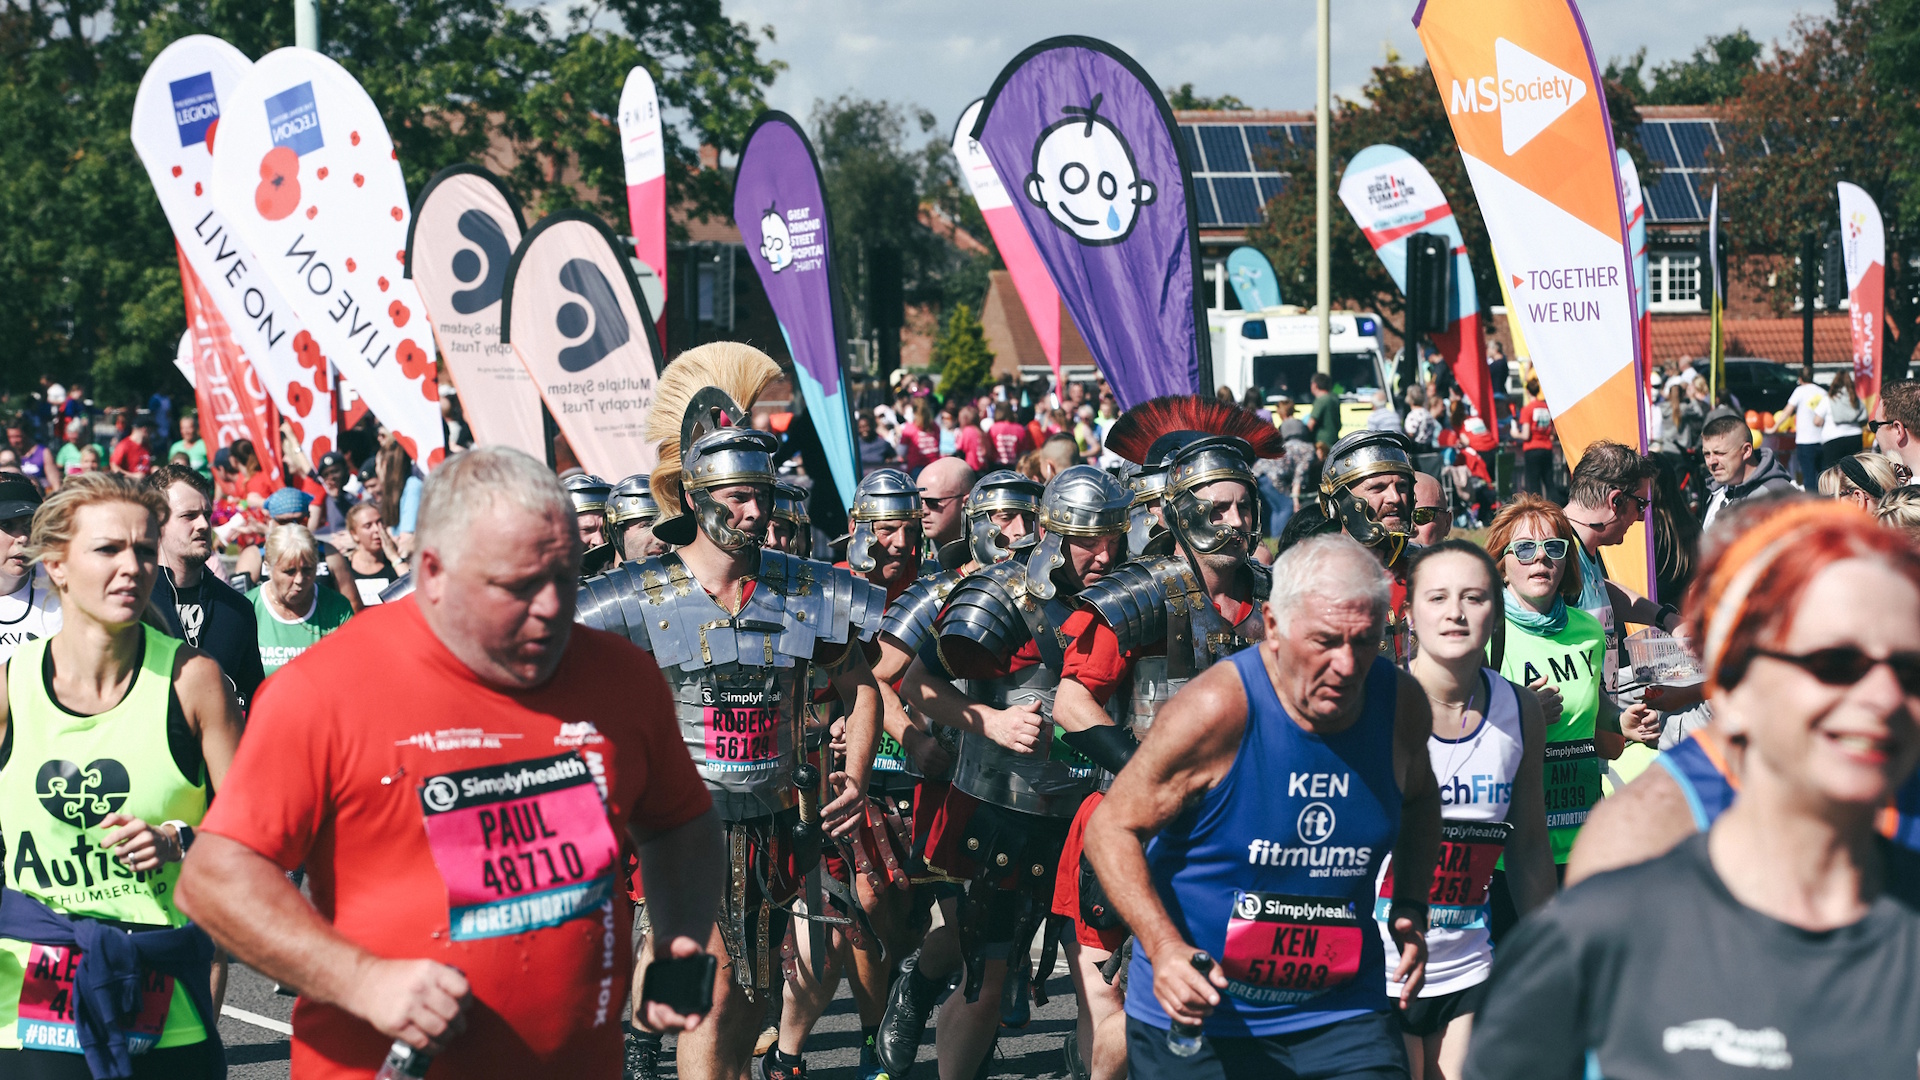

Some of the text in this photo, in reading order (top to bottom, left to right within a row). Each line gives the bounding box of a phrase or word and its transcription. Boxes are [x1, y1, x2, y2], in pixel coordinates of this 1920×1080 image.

[1450, 75, 1573, 115] MS Society
[175, 102, 219, 126] LEGION
[195, 210, 248, 288] LIVE
[243, 286, 286, 350] ON
[1527, 265, 1619, 290] TOGETHER
[1528, 300, 1600, 323] WE RUN
[1524, 650, 1594, 687] AMY
[712, 709, 777, 733] ROBERT
[1545, 743, 1596, 758] Simplyhealth
[460, 757, 587, 799] Simplyhealth
[1287, 771, 1350, 798] KEN
[1551, 762, 1579, 785] AMY
[1440, 774, 1517, 806] chFirs
[478, 800, 558, 851] PAUL
[13, 829, 164, 890] Autis
[1248, 838, 1372, 867] fitmums
[482, 841, 586, 897] 48710
[1309, 865, 1368, 878] and friends
[1270, 926, 1320, 959] KEN
[1247, 959, 1329, 991] 51383
